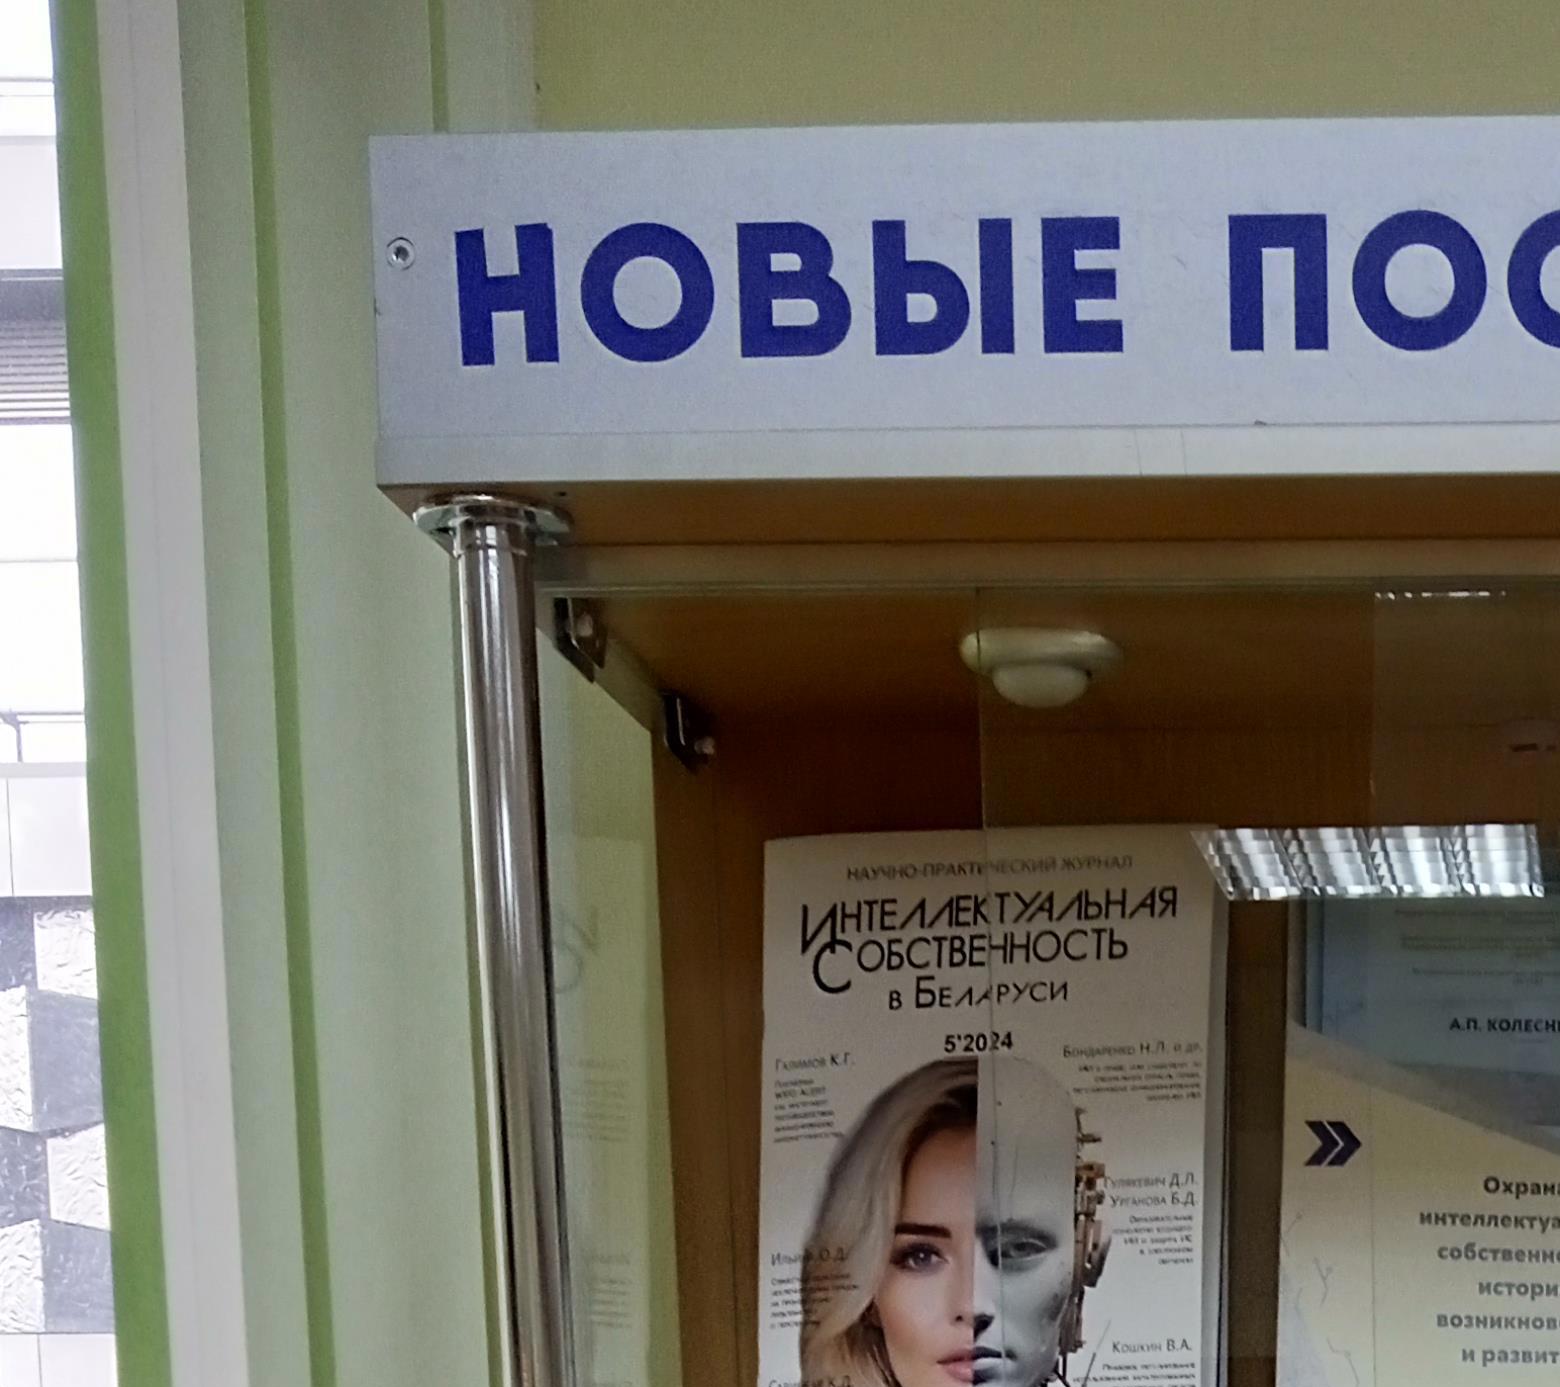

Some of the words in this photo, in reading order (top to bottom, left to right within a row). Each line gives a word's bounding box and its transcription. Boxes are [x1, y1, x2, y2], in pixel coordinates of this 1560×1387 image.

[457, 216, 1123, 367] НОВЫЕ
[1060, 856, 1133, 872] ЖУРНАЛ
[1449, 1017, 1482, 1033] А.П.
[944, 1031, 1013, 1053] 5'2024
[1461, 1346, 1474, 1362] и
